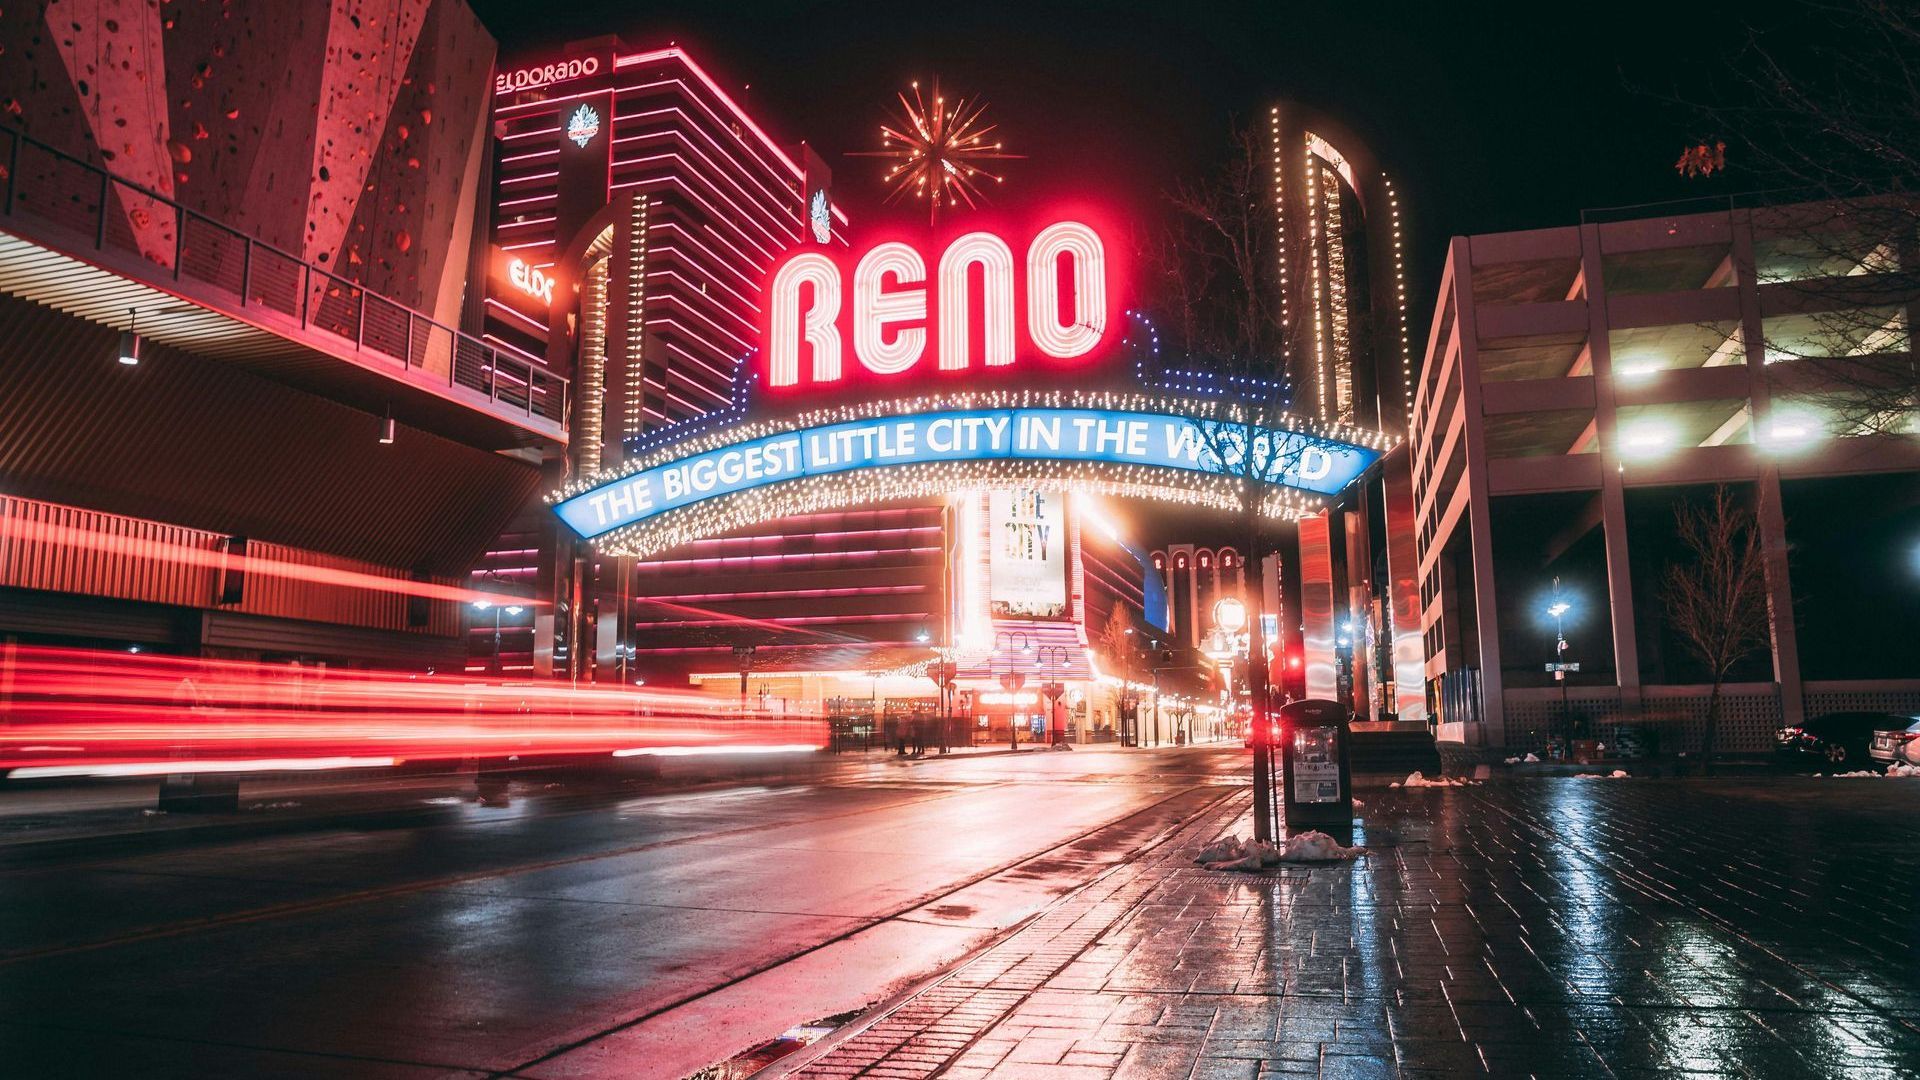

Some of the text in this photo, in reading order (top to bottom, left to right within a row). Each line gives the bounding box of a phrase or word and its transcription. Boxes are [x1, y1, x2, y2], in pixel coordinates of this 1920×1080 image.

[770, 221, 1106, 386] RENO
[588, 480, 653, 525] THE
[662, 438, 799, 499] BIGGEST
[811, 423, 916, 467] LITTLE
[927, 416, 1011, 453] CITY
[1018, 416, 1061, 451] IN
[1072, 417, 1148, 456] THE
